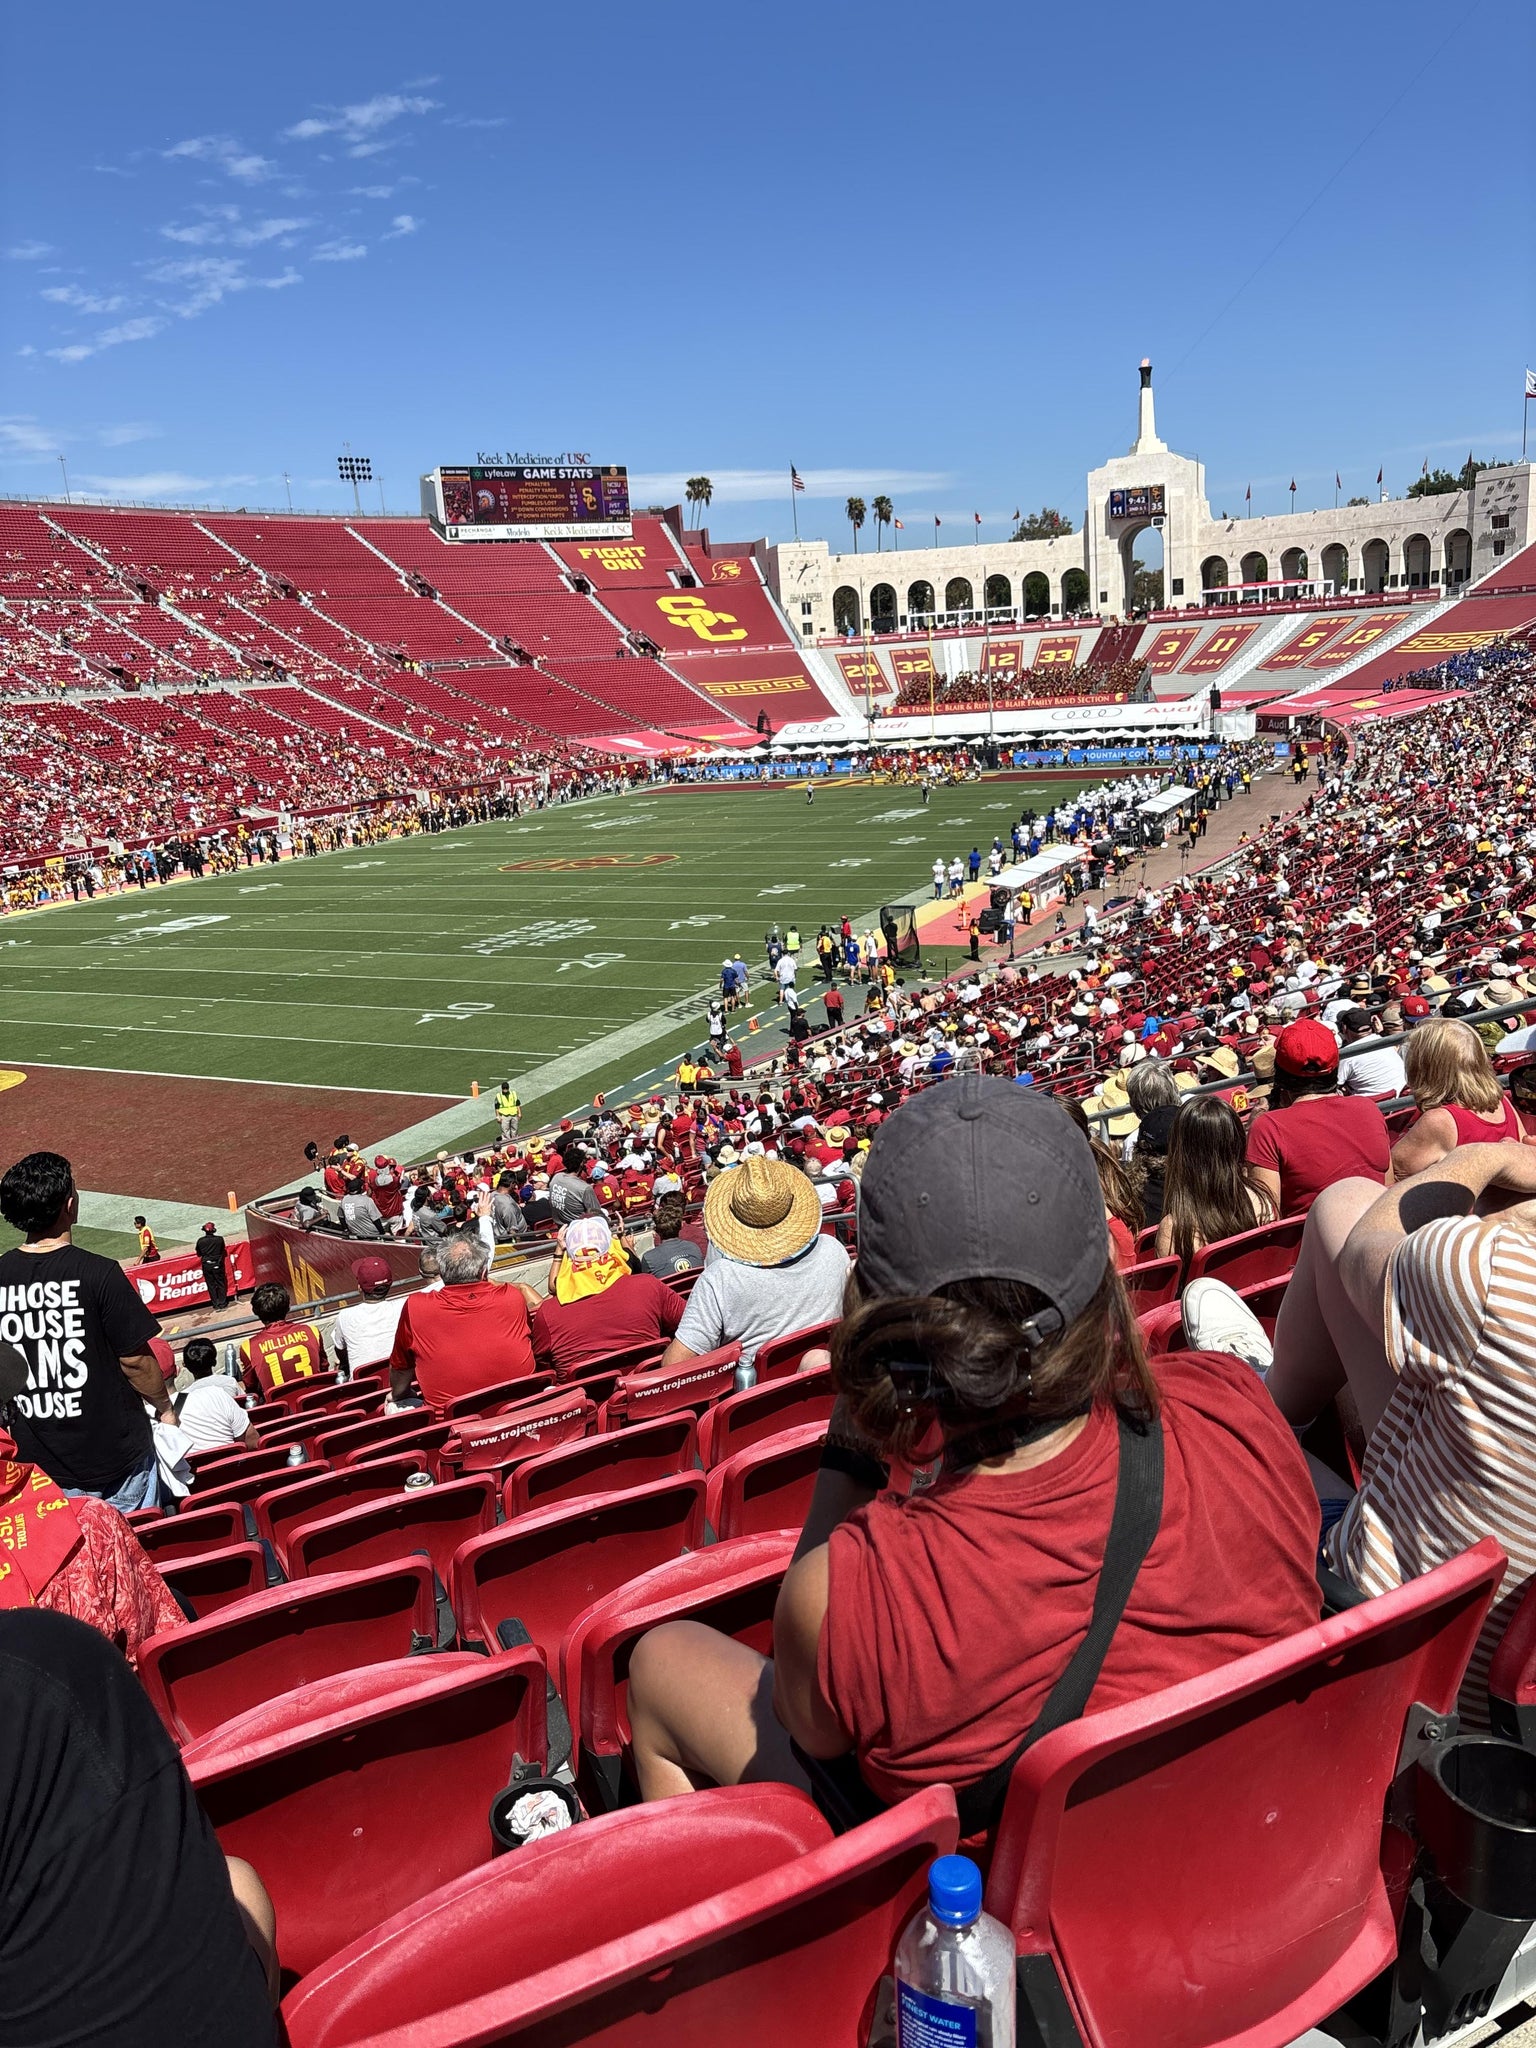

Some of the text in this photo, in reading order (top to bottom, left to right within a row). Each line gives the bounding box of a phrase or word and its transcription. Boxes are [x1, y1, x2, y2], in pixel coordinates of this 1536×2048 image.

[476, 452, 592, 465] Keck Medicine of USC
[523, 468, 594, 479] GAME STATS
[1128, 496, 1146, 504] 9:42
[1152, 502, 1162, 510] 35
[544, 526, 563, 536] Keck
[566, 526, 600, 535] Medicine
[612, 525, 630, 534] USC
[578, 546, 646, 560] FIGHT
[602, 558, 644, 571] ON!
[1298, 632, 1328, 647] 5
[1342, 628, 1383, 644] 13
[1158, 641, 1180, 656] 3
[1208, 638, 1238, 652] 11
[989, 652, 1016, 667] 12
[1038, 648, 1074, 663] 33
[844, 664, 879, 678] 20
[896, 660, 932, 674] 32
[944, 704, 965, 712] BLAIR
[1078, 696, 1110, 704] SECTION
[1144, 705, 1198, 714] Audi
[1268, 719, 1287, 730] Audi
[461, 920, 557, 949] UNITED
[476, 919, 590, 955] AIRLINES
[526, 925, 598, 946] FIELD
[560, 953, 626, 968] 20
[422, 1002, 495, 1020] 10
[552, 1184, 568, 1196] CSC
[602, 1186, 612, 1199] 9
[158, 1266, 205, 1288] Unite
[159, 1269, 243, 1302] Rentas
[0, 1308, 86, 1342] OUSE
[258, 1330, 309, 1354] WILLIAMS
[12, 1338, 88, 1390] AMS
[264, 1345, 313, 1386] 13
[634, 1360, 736, 1398] www.trojanseats.com
[14, 1391, 82, 1418] OUSE
[470, 1407, 582, 1448] www.trojanseats.com
[14, 1513, 28, 1550] TROJANS
[902, 1998, 962, 2030] FINEST WATER
